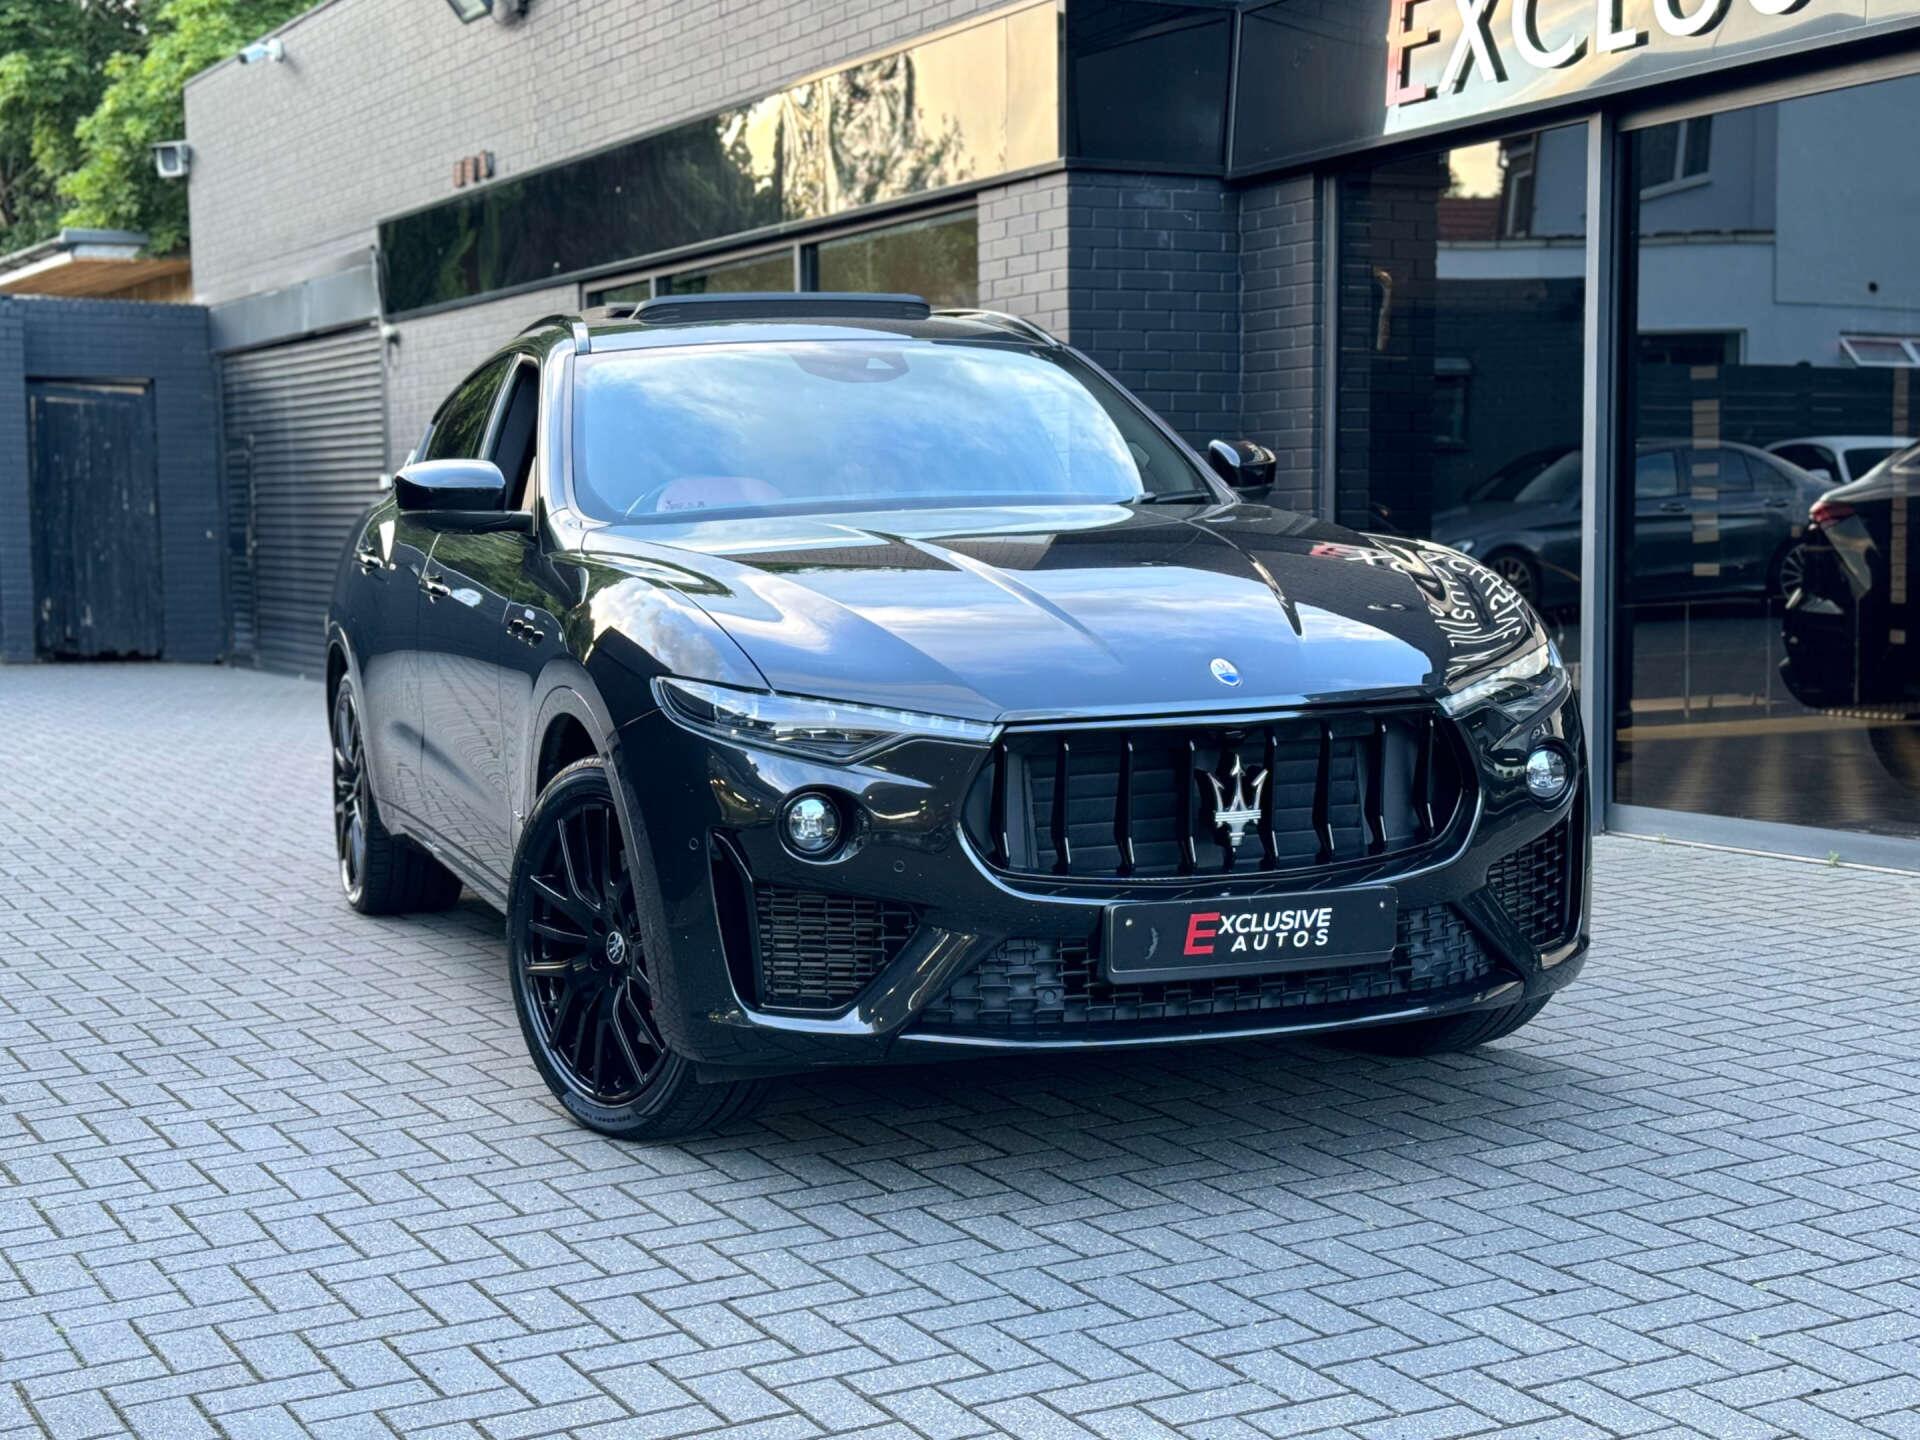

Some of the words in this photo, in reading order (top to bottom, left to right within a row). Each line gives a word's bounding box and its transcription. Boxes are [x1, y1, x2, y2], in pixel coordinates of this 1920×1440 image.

[1386, 0, 1798, 107] EXCL
[1183, 908, 1333, 956] EXCLUSIVE
[1231, 928, 1329, 953] AUTOS
